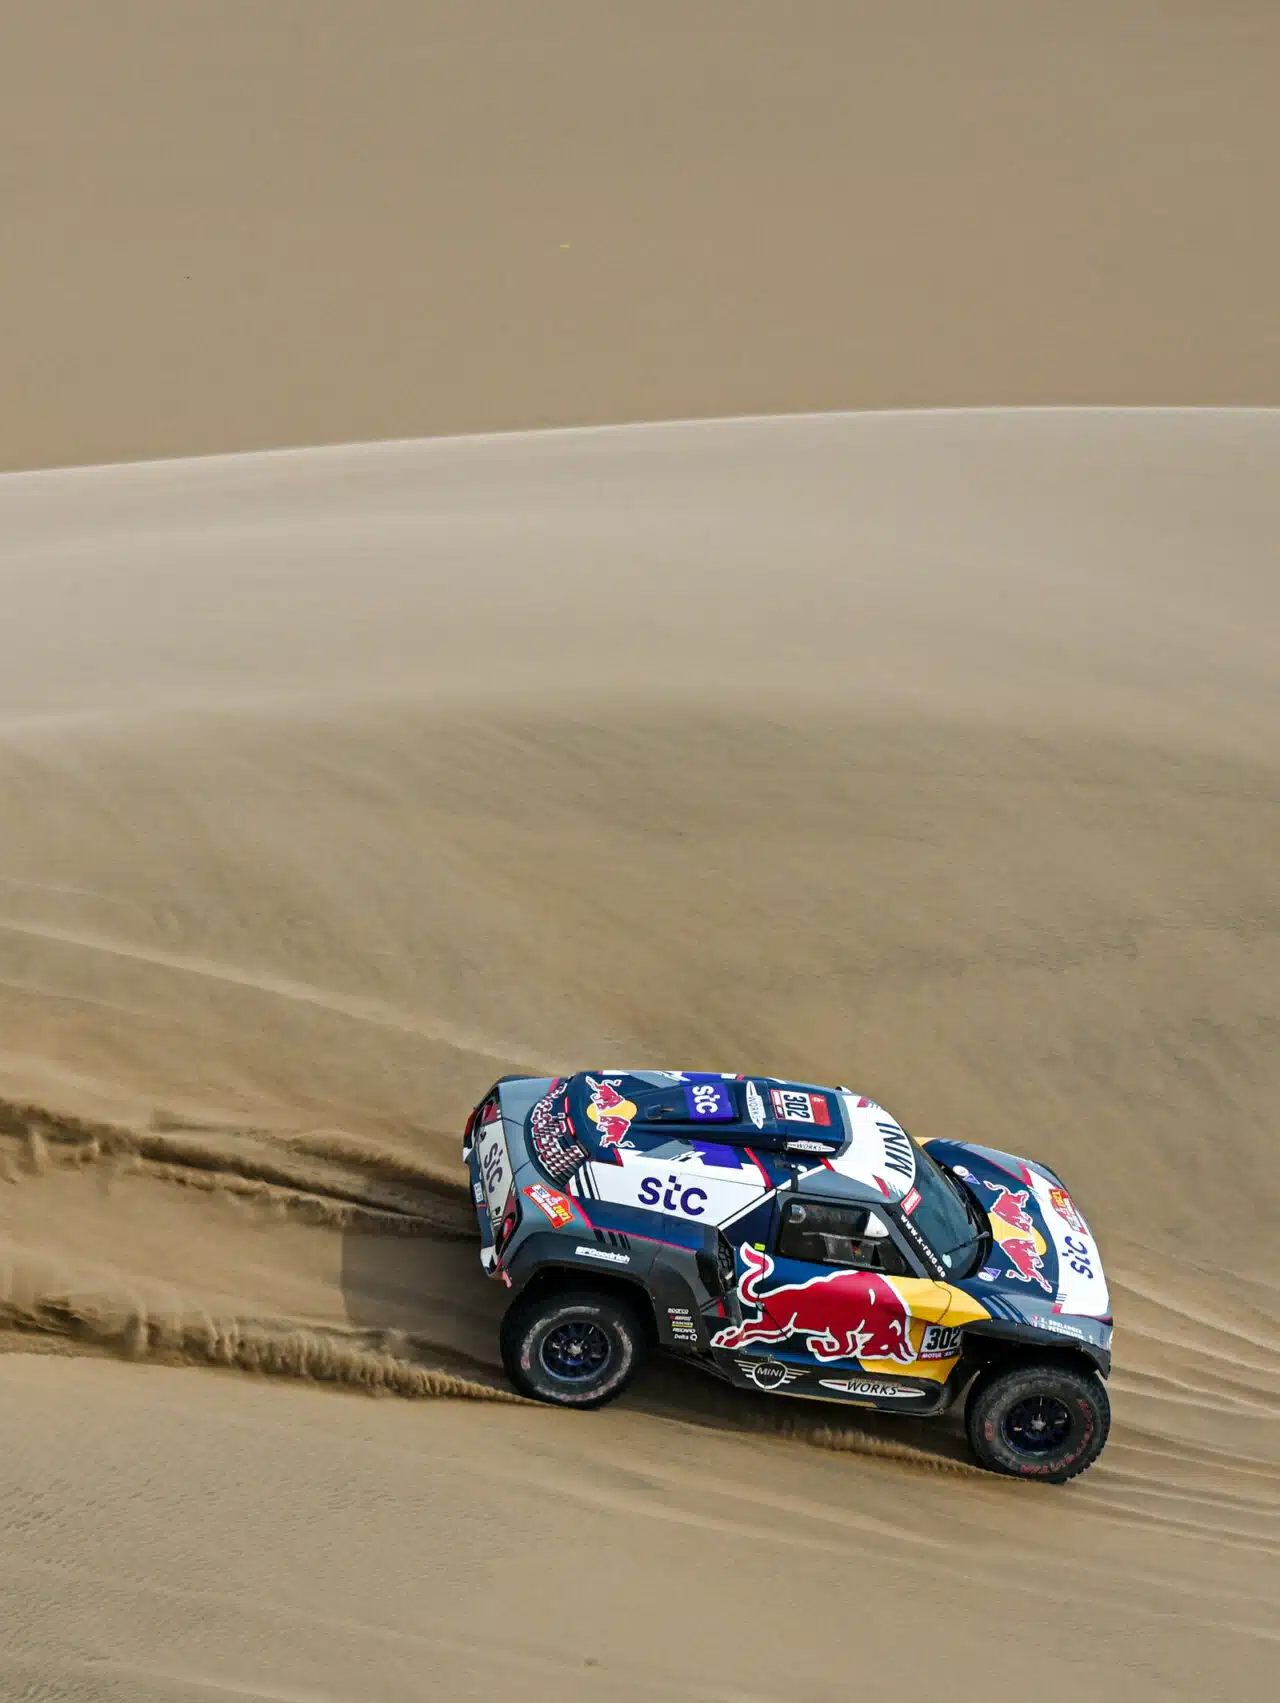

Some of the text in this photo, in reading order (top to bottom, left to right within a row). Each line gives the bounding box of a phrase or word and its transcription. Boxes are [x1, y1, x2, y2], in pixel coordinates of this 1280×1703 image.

[692, 1085, 720, 1115] stc
[783, 1094, 810, 1119] 302
[796, 1143, 822, 1151] WORKS
[875, 1122, 913, 1179] MINI
[484, 1142, 503, 1193] stc
[637, 1175, 708, 1216] stc
[553, 1204, 571, 1222] 2021
[575, 1246, 630, 1264] BFGoodrich
[900, 1214, 946, 1278] www.x-raid.de
[1062, 1236, 1093, 1279] stc
[926, 1327, 960, 1350] 302
[757, 1367, 783, 1378] MINI
[846, 1380, 899, 1396] WORKS
